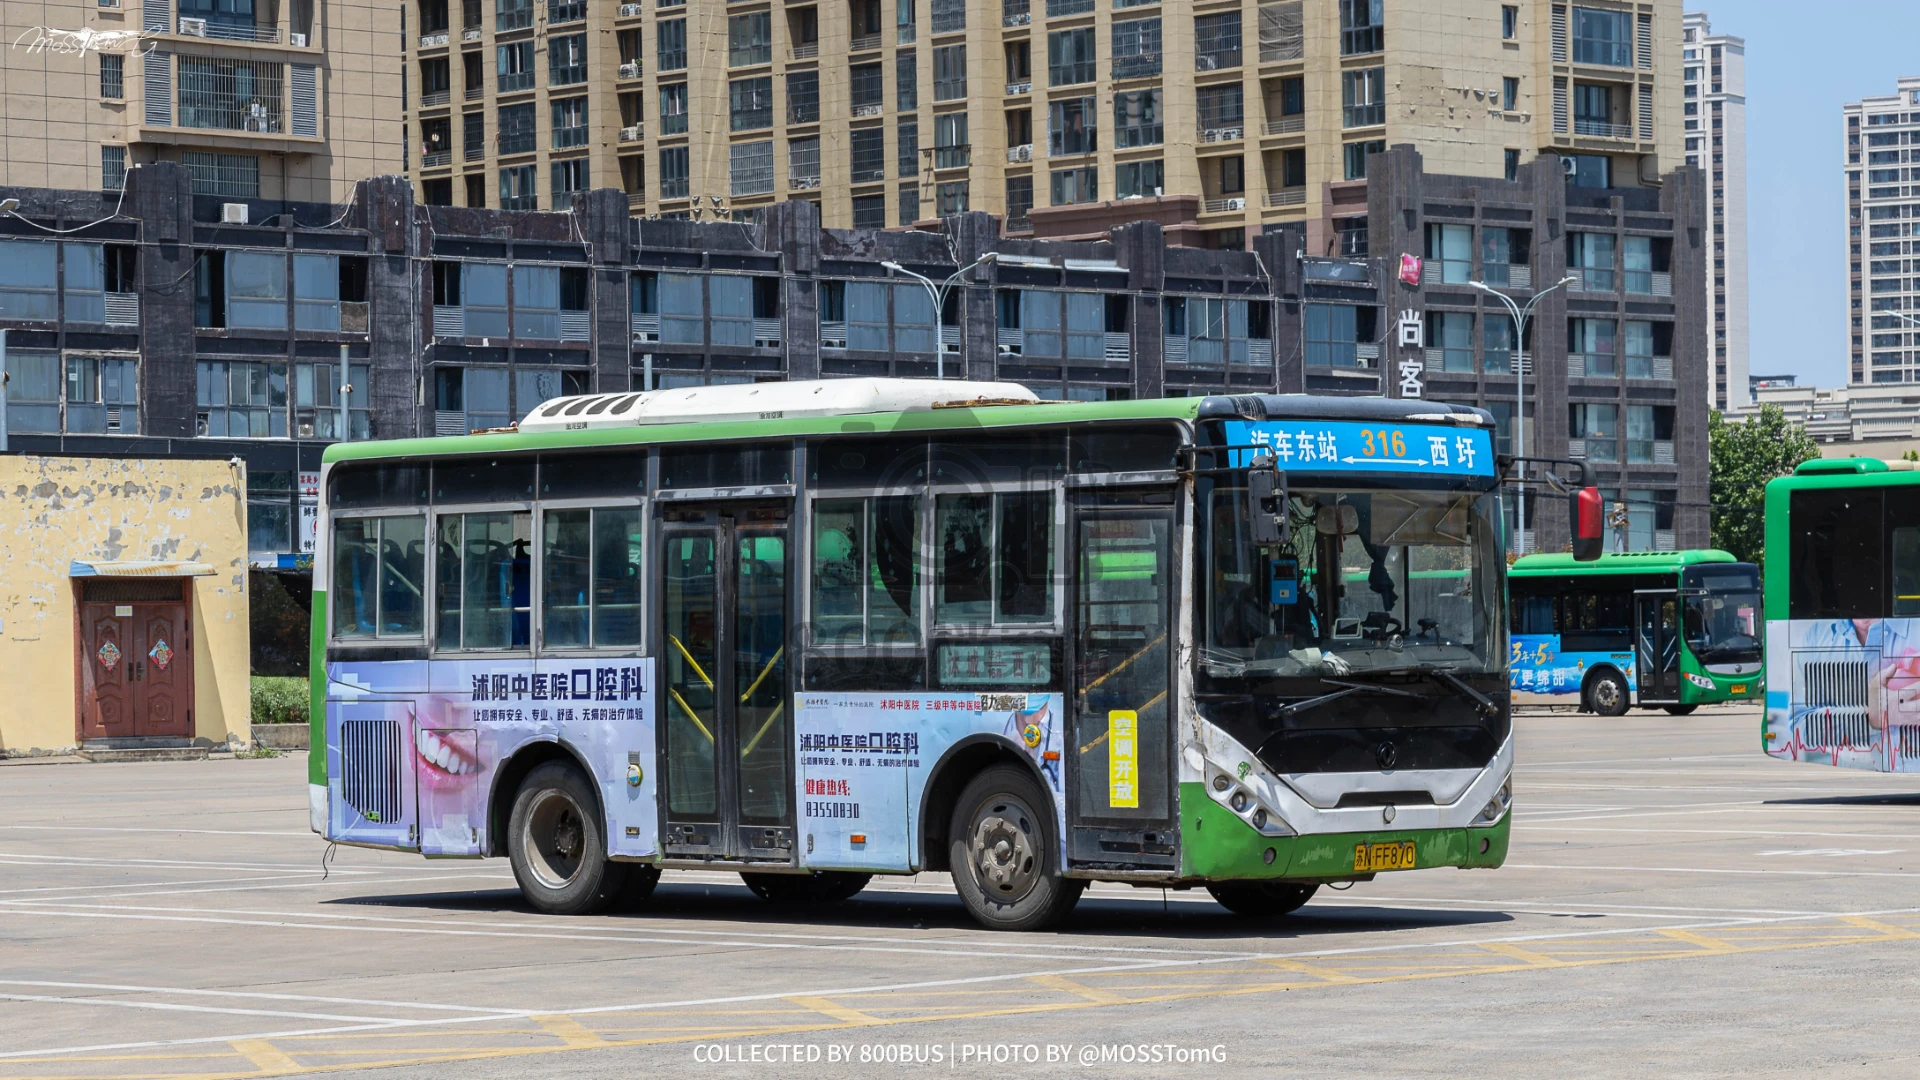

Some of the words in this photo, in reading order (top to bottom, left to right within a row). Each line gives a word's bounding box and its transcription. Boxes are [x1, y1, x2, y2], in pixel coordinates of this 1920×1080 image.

[1250, 430, 1338, 463] 汽车东站
[1360, 429, 1407, 457] 316
[1428, 435, 1476, 469] 西圩
[472, 666, 643, 701] 沭阳中医院口腔科
[926, 700, 982, 711] 三级甲等中医院
[1114, 716, 1133, 800] 空调开放
[806, 801, 860, 819] 83550830
